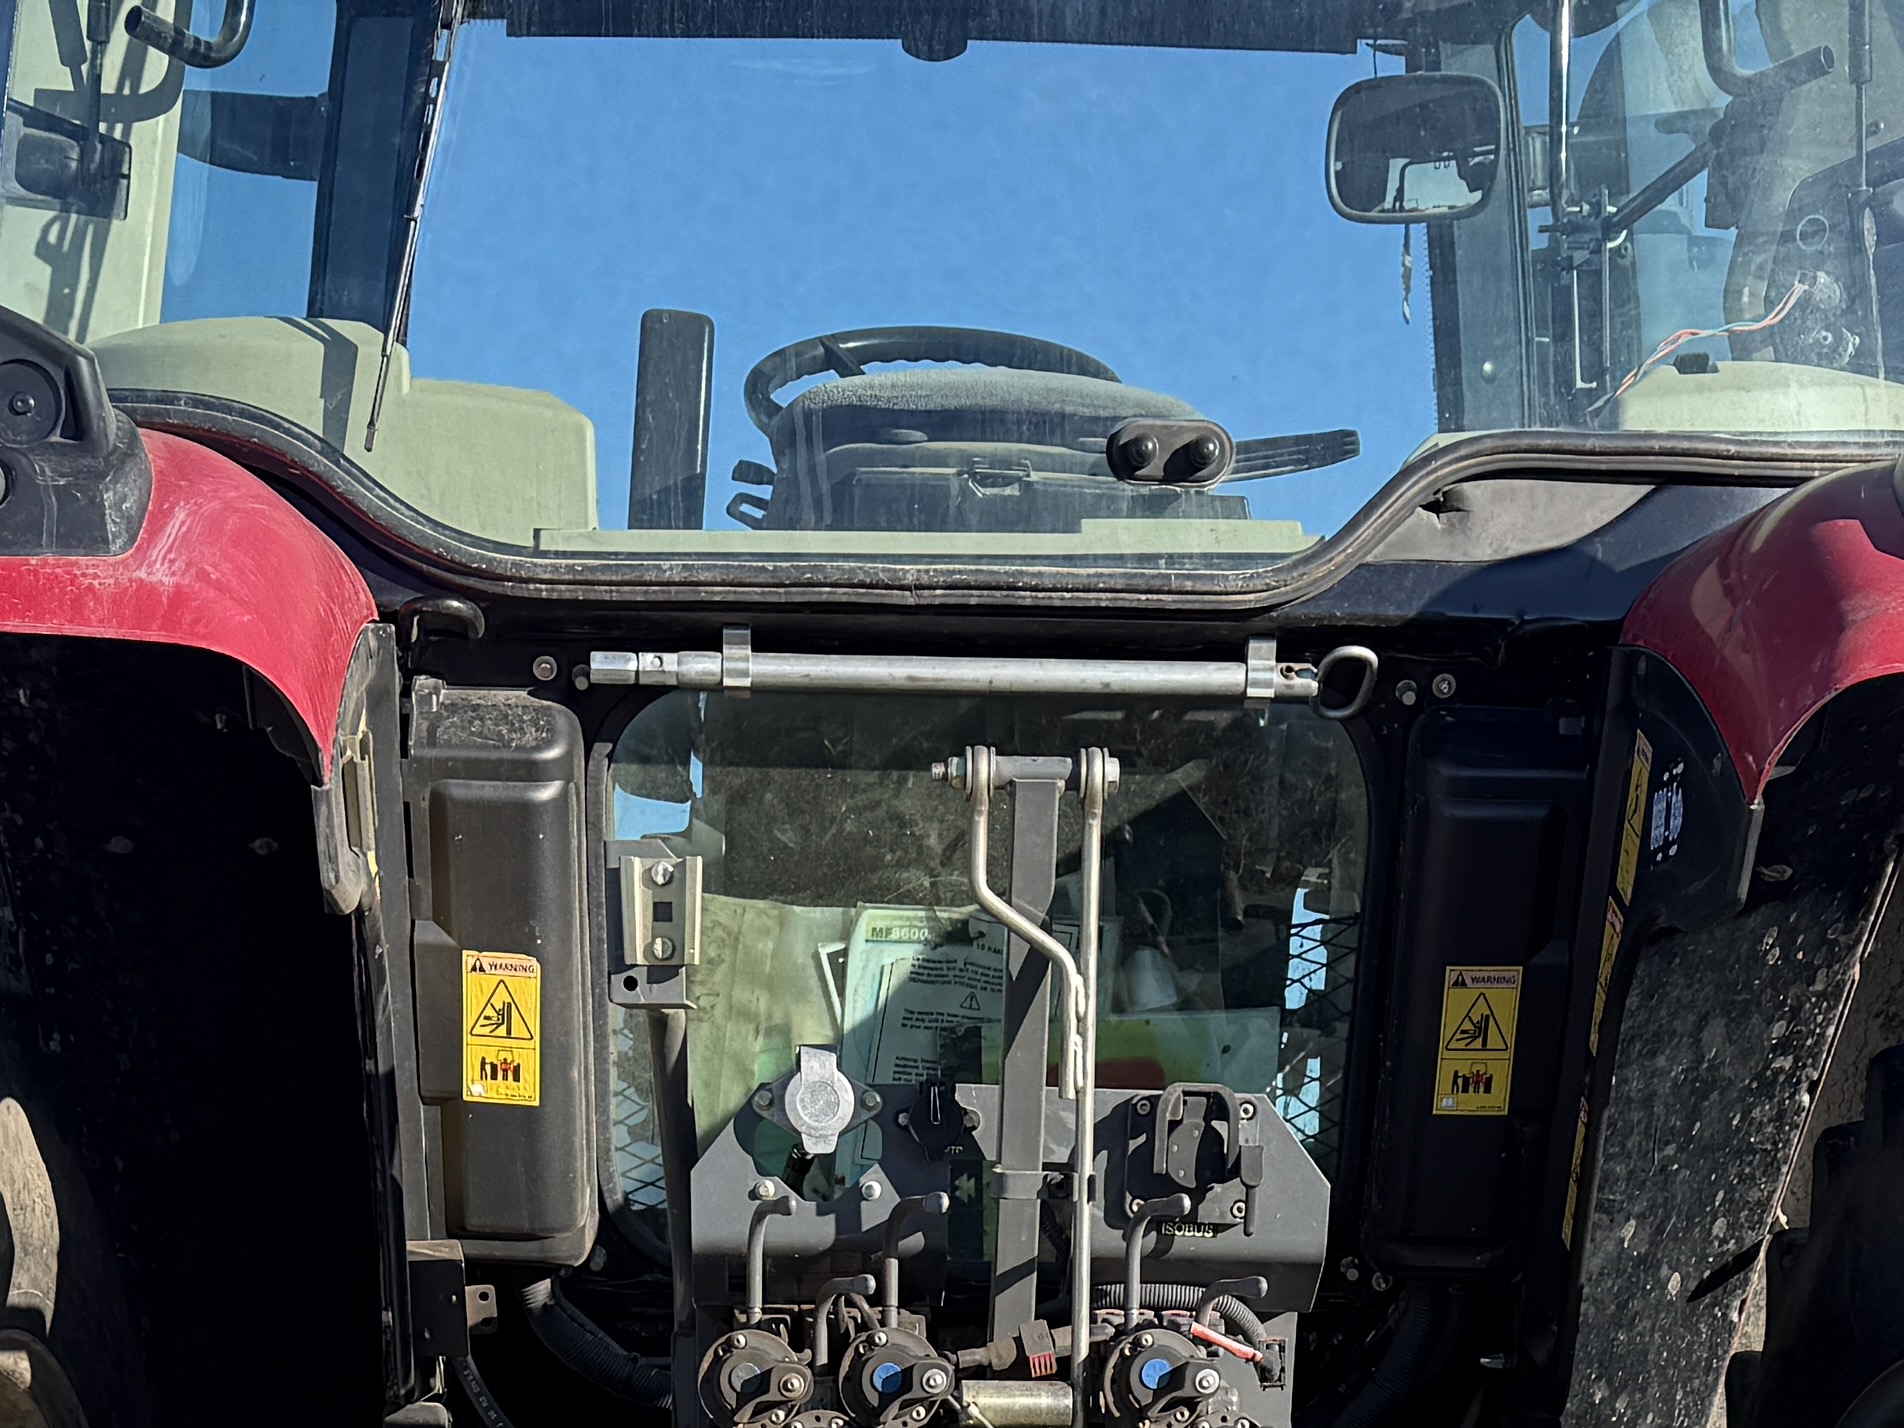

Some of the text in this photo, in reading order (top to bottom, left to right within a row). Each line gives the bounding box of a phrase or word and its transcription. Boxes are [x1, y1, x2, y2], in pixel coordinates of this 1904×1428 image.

[487, 961, 536, 974] WARNING
[1469, 974, 1517, 986] WARNING
[1161, 1222, 1214, 1238] ISOBUS
